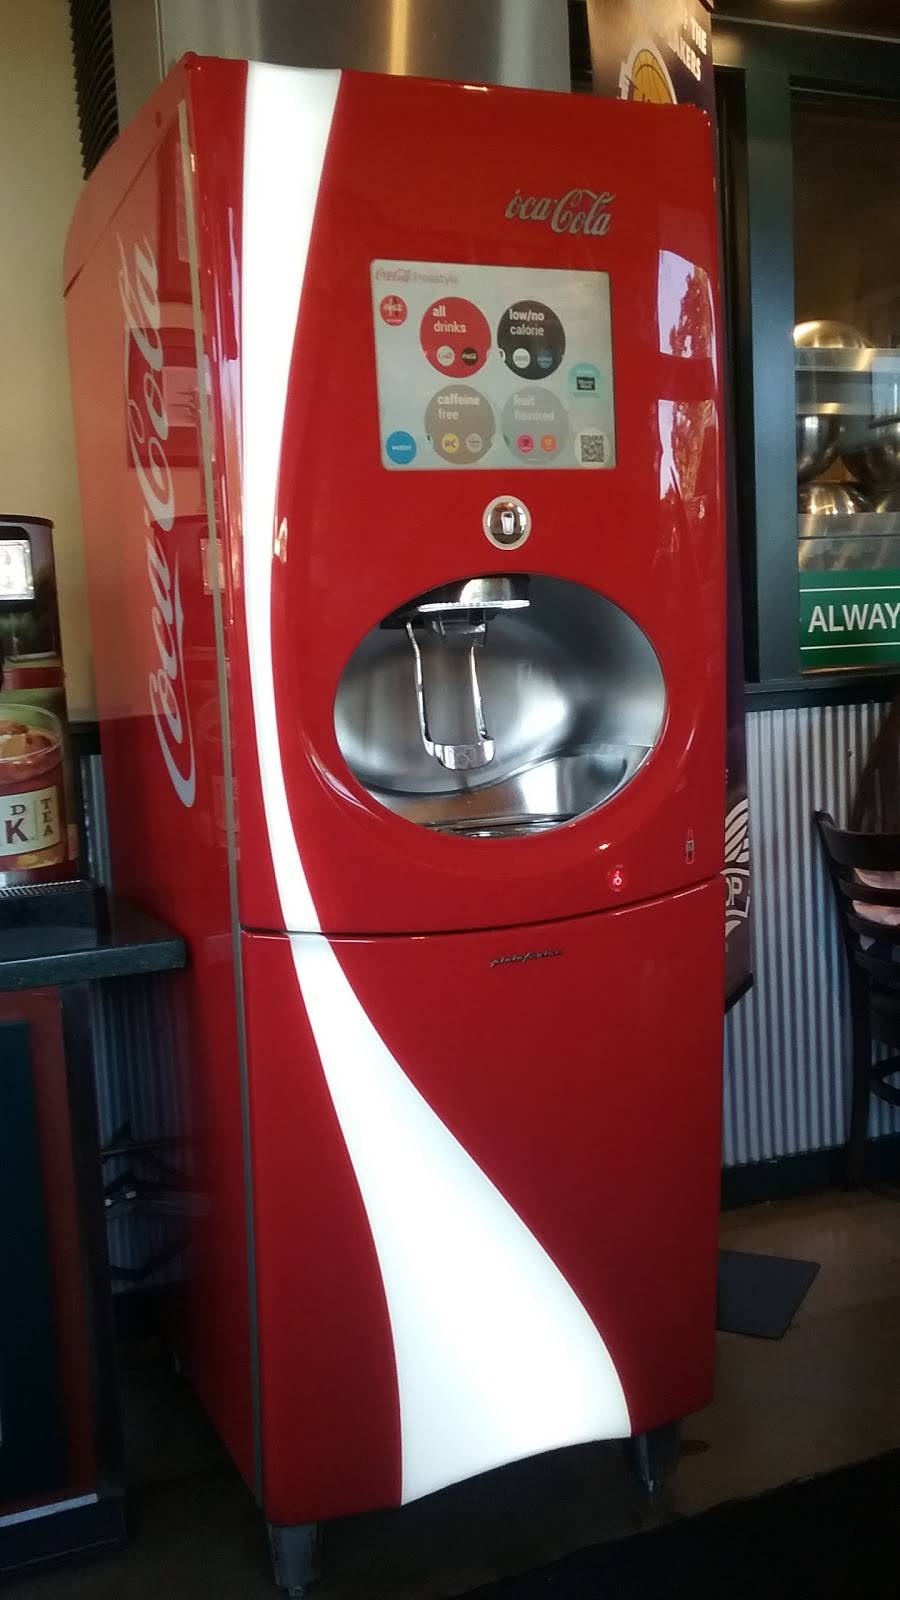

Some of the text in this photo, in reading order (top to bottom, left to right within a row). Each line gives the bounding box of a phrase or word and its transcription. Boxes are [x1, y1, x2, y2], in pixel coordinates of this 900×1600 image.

[691, 16, 707, 55] THE
[665, 30, 701, 82] AKERS
[432, 304, 446, 317] all
[508, 308, 545, 321] low/no
[433, 320, 467, 333] drinks
[509, 323, 545, 336] calorie
[437, 393, 481, 406] caffeine
[513, 394, 536, 406] fruit
[437, 408, 460, 420] free
[514, 409, 555, 421] flavored
[40, 797, 54, 838] TEA
